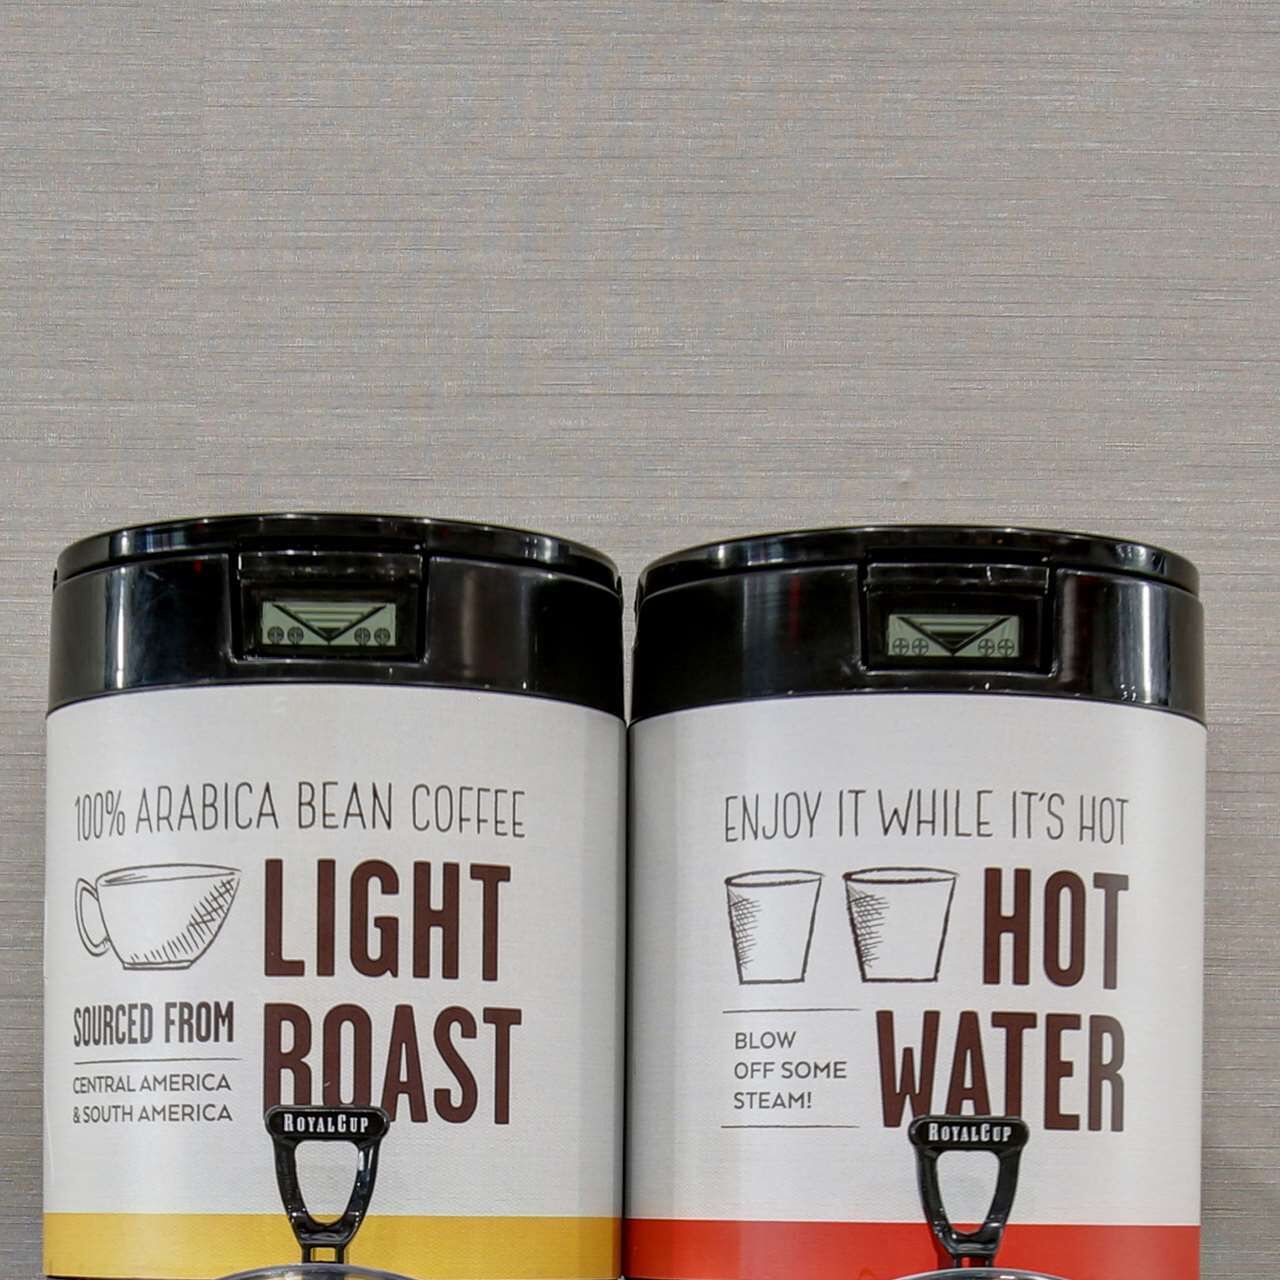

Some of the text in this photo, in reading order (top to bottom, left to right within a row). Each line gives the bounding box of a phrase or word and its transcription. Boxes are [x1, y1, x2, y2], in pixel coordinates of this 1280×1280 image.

[74, 780, 526, 842] 100% ARABICA BEAN COFFEE
[724, 788, 1129, 846] ENJOY IT WHILE IT'S HOT
[263, 857, 512, 982] LIGHT
[982, 867, 1129, 990] HOT
[73, 1000, 235, 1048] SOURCED FROM
[734, 1030, 797, 1050] BLOW
[72, 1072, 233, 1095] CENTRAL AMERICA
[263, 1002, 522, 1125] ROAST
[733, 1060, 848, 1080] OFF SOME
[876, 1010, 1126, 1132] WATER
[137, 1103, 234, 1123] AMERICA
[733, 1090, 813, 1110] STEAM!
